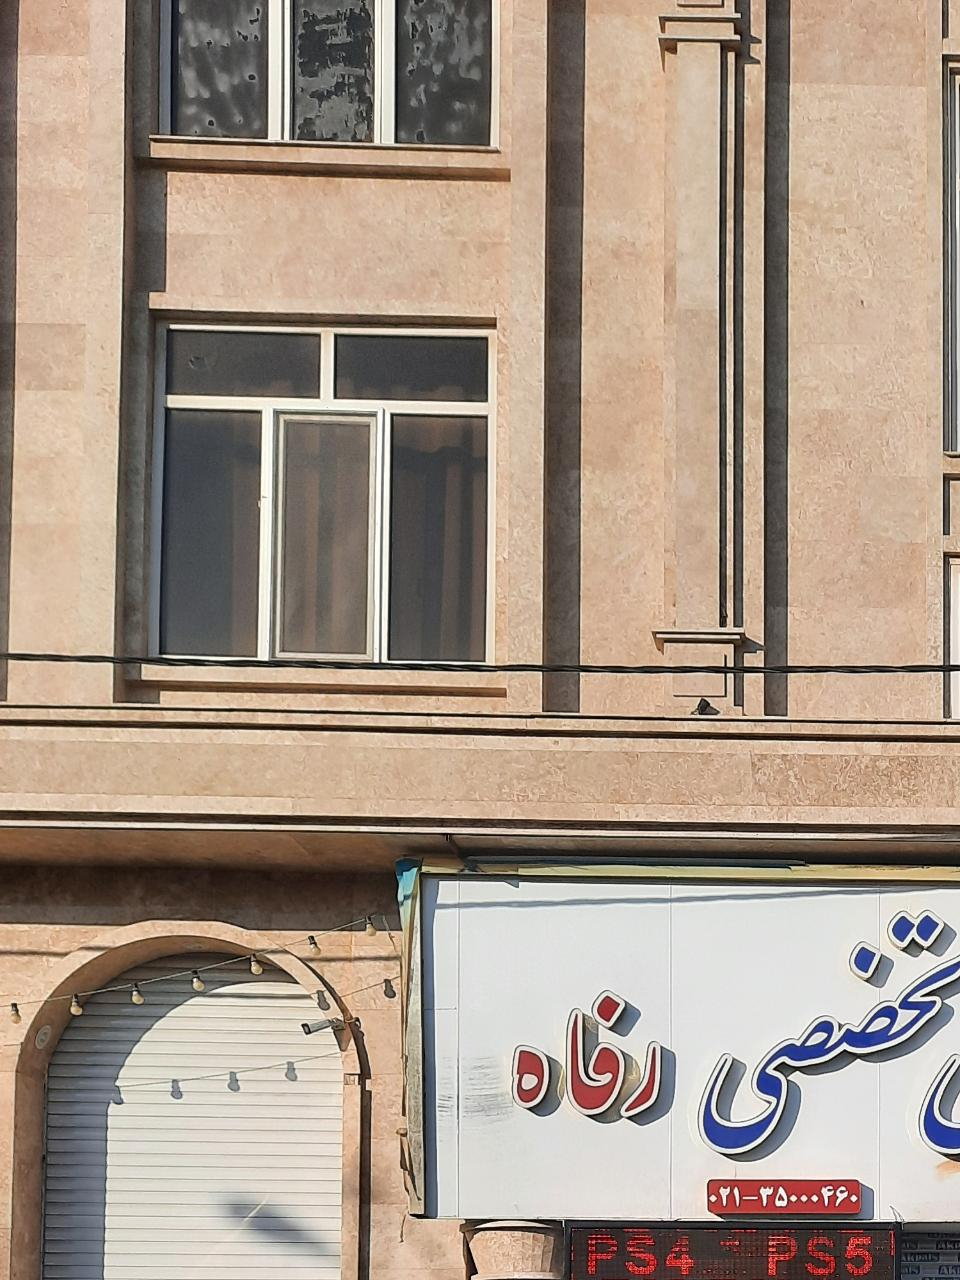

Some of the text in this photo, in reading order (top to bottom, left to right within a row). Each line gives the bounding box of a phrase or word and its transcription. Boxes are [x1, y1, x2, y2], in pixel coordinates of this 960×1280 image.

[512, 990, 665, 1117] رفاه
[587, 1236, 874, 1276] PS4 PS5
